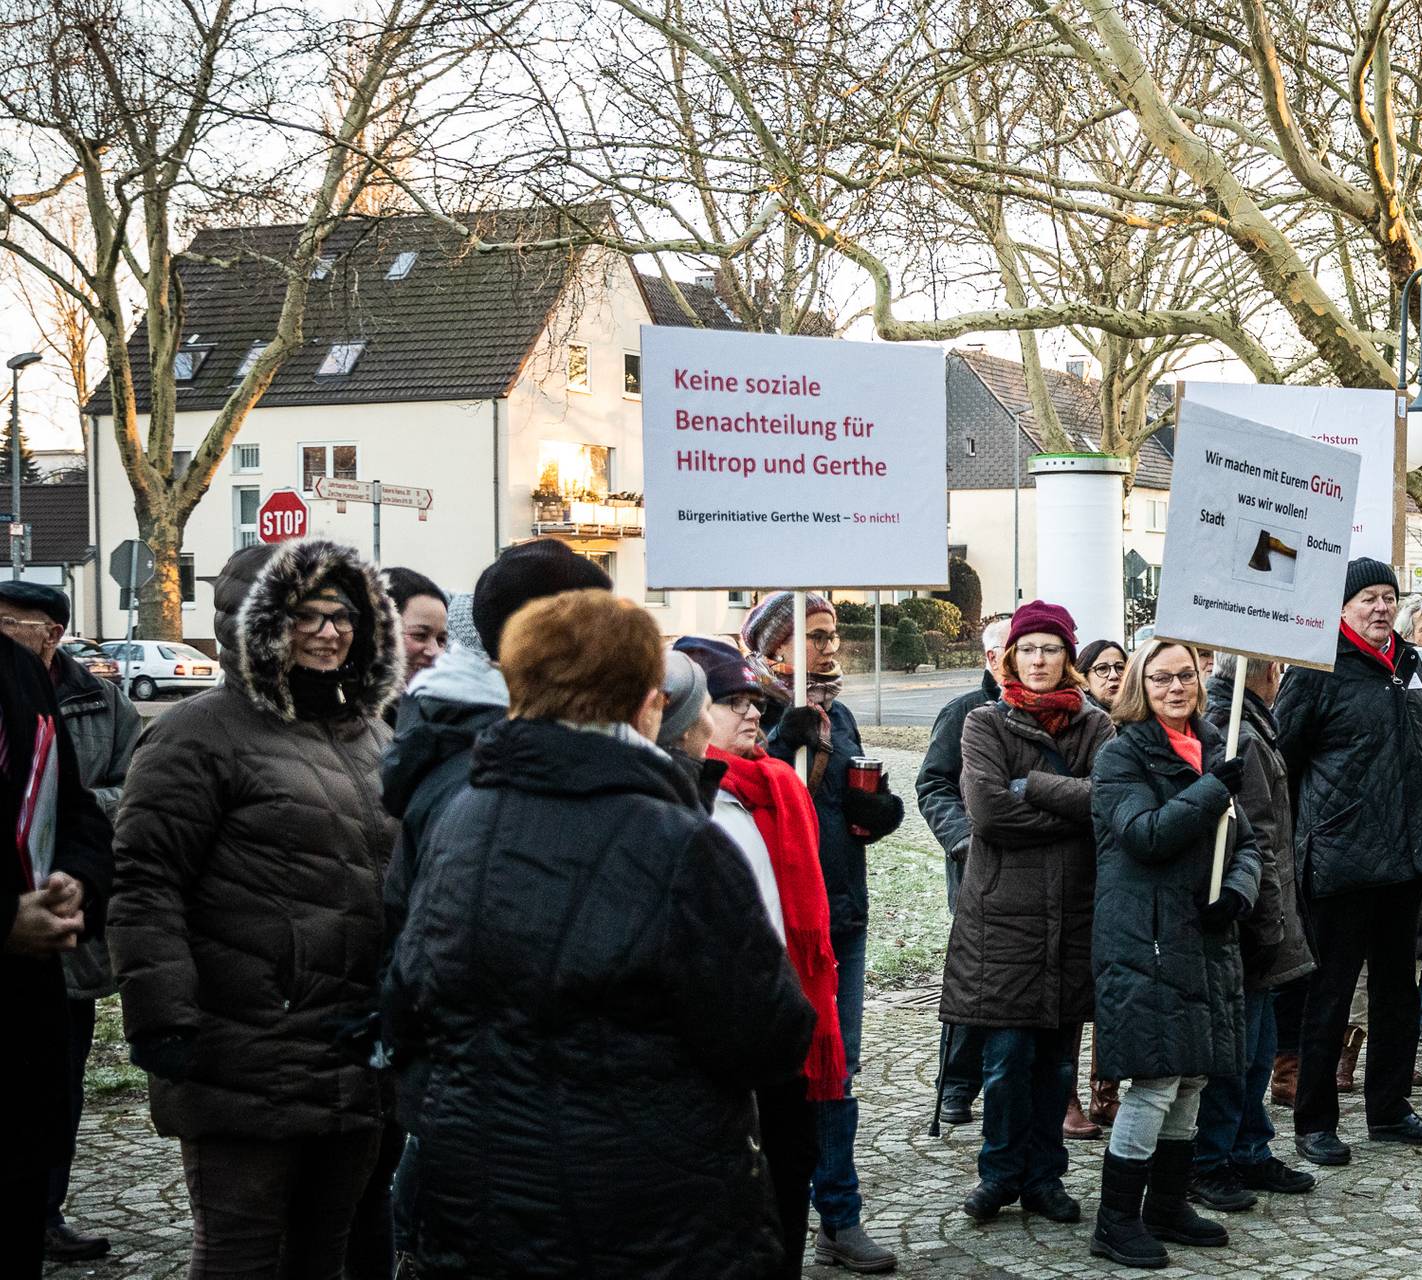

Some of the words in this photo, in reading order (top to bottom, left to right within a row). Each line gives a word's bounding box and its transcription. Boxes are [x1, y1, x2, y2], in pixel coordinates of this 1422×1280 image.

[675, 369, 737, 392] Keine
[746, 375, 820, 396] soziale
[676, 410, 836, 441] Benachteilung
[843, 417, 874, 437] für
[678, 450, 756, 477] Hiltrop
[765, 454, 805, 474] und
[813, 455, 886, 476] Gerthe
[1206, 450, 1223, 466] Wir
[1225, 459, 1261, 477] machen
[1263, 469, 1278, 482] mit
[1281, 472, 1308, 490] Eurem
[1311, 475, 1343, 501] Grün,
[678, 510, 767, 523] Bürgerinitiative
[771, 512, 809, 522] Gerthe
[813, 512, 840, 522] West
[854, 513, 866, 523] So
[870, 513, 899, 523] nicht!
[1238, 494, 1255, 506] was
[1259, 498, 1273, 510] wir
[1275, 503, 1308, 520] wollen!
[263, 510, 304, 535] STOP
[1200, 509, 1225, 526] Stadt
[1307, 536, 1341, 554] Bochum
[1193, 595, 1246, 614] Bürgerinitiative
[1247, 606, 1270, 619] Gerthe
[1296, 616, 1304, 625] So
[1306, 618, 1324, 628] nicht!
